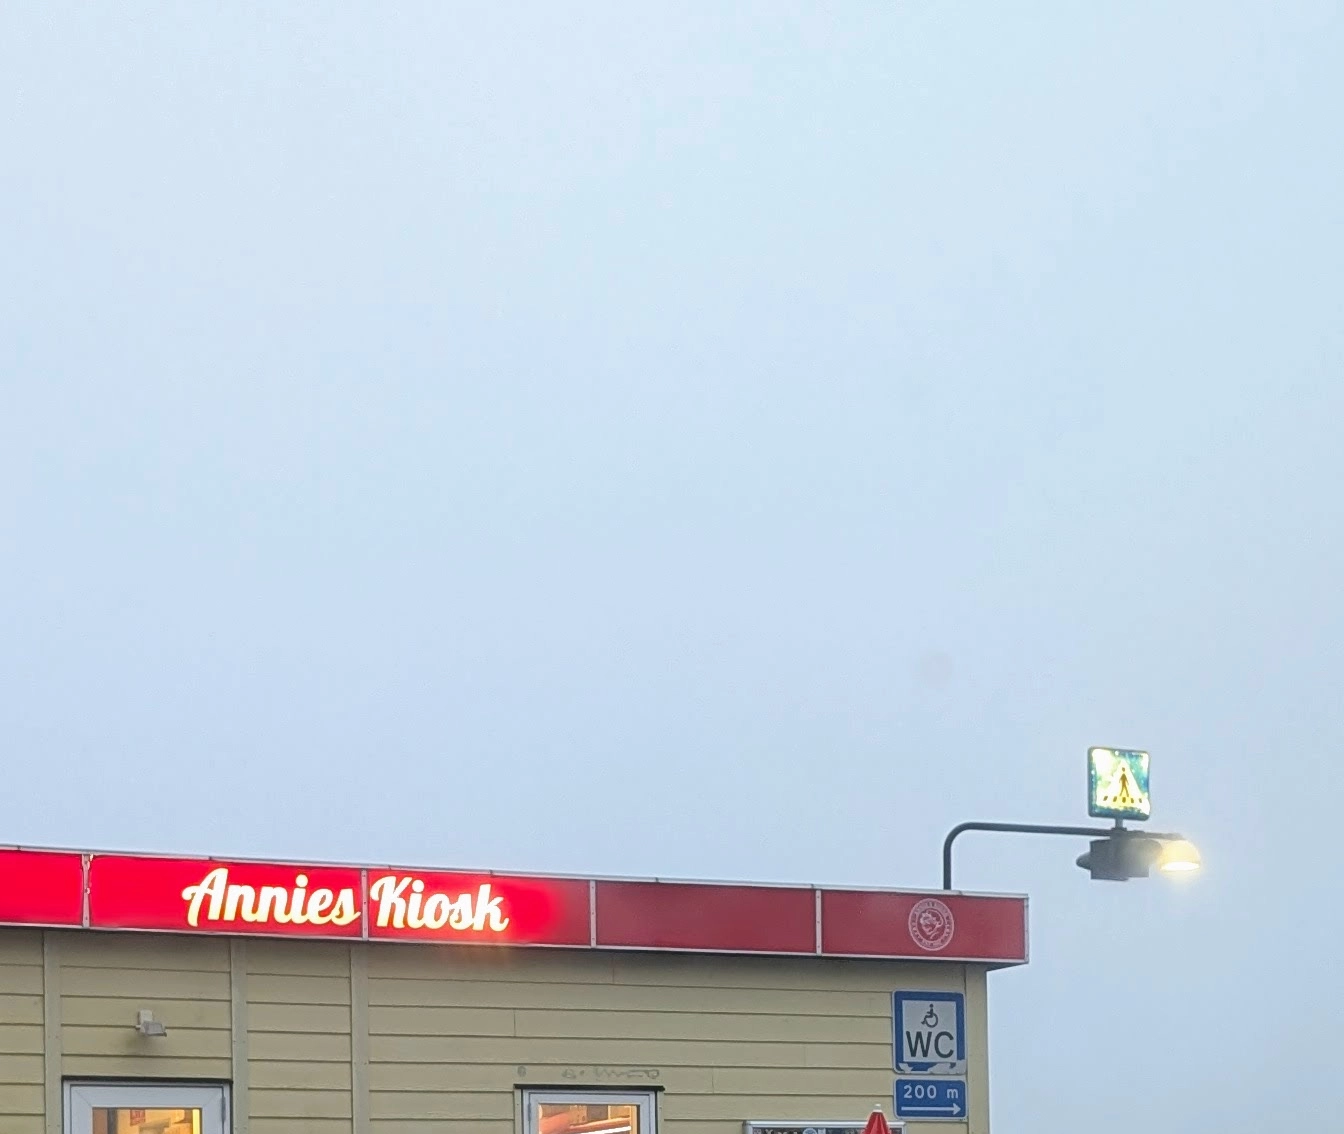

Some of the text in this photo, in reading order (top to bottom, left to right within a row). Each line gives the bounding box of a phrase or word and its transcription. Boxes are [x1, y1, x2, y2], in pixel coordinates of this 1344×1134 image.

[181, 867, 510, 932] Annies Kiosk
[905, 1030, 955, 1059] WC
[903, 1084, 959, 1099] 200 m
